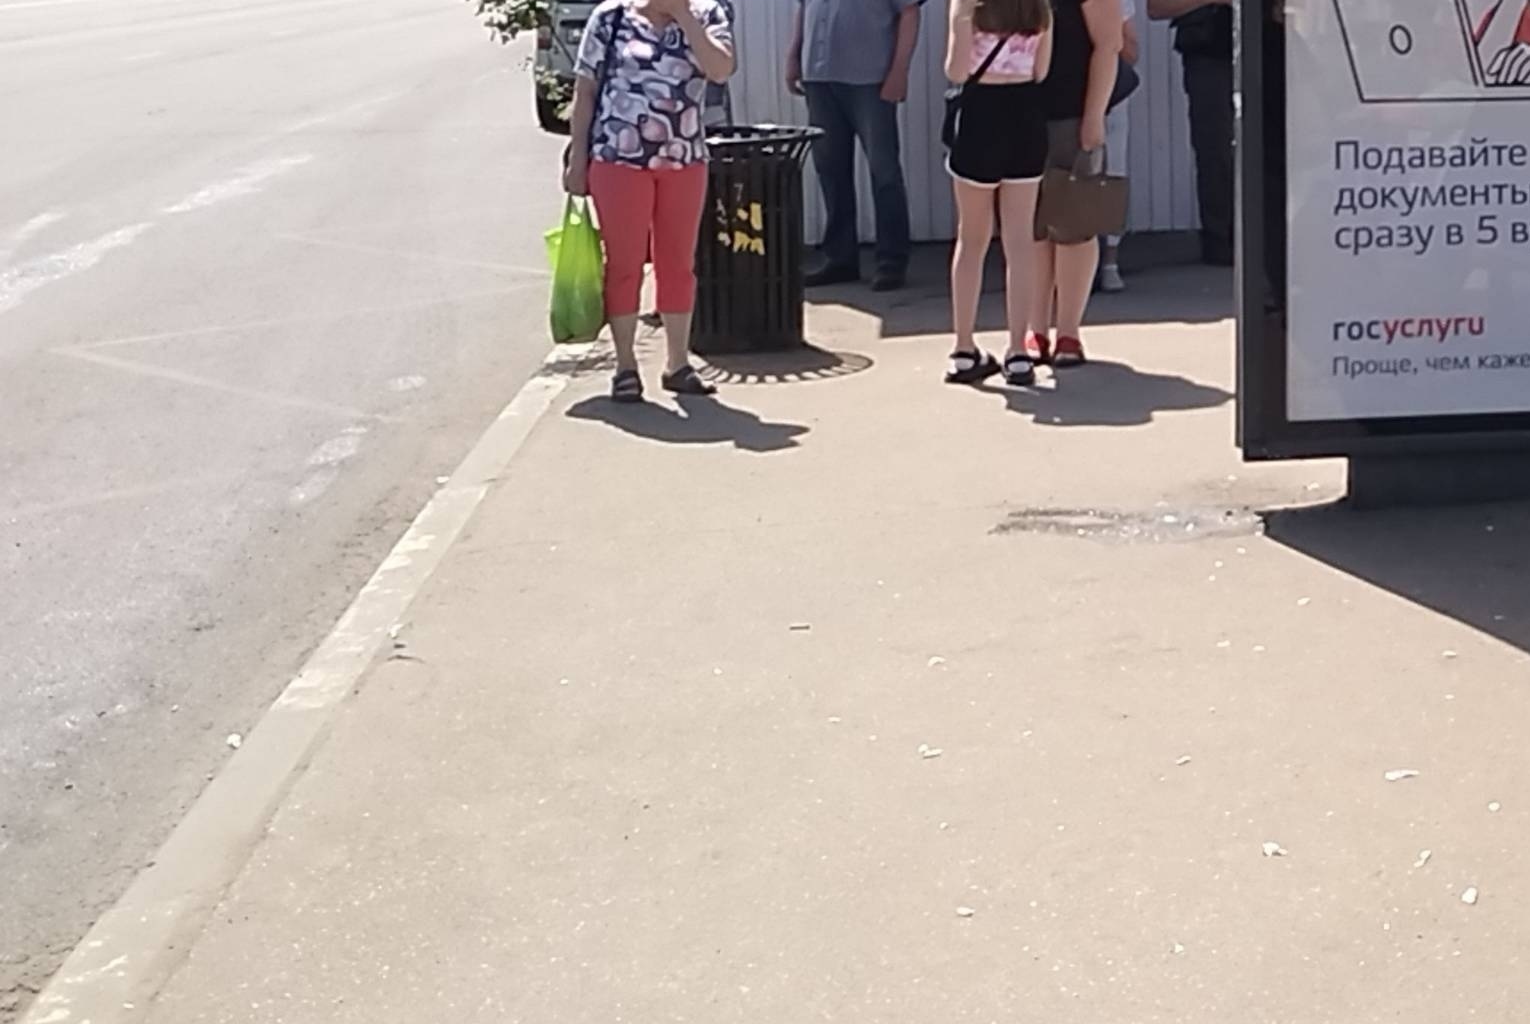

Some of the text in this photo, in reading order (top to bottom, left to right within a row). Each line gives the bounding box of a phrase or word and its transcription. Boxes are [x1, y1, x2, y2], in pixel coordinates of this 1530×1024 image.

[1334, 137, 1528, 174] Подавайте
[1334, 222, 1434, 255] сразу
[1446, 223, 1464, 245] в
[1476, 215, 1499, 245] 5
[1333, 316, 1485, 344] госуслуги
[1333, 356, 1418, 379] Проще,
[1426, 354, 1470, 371] чем
